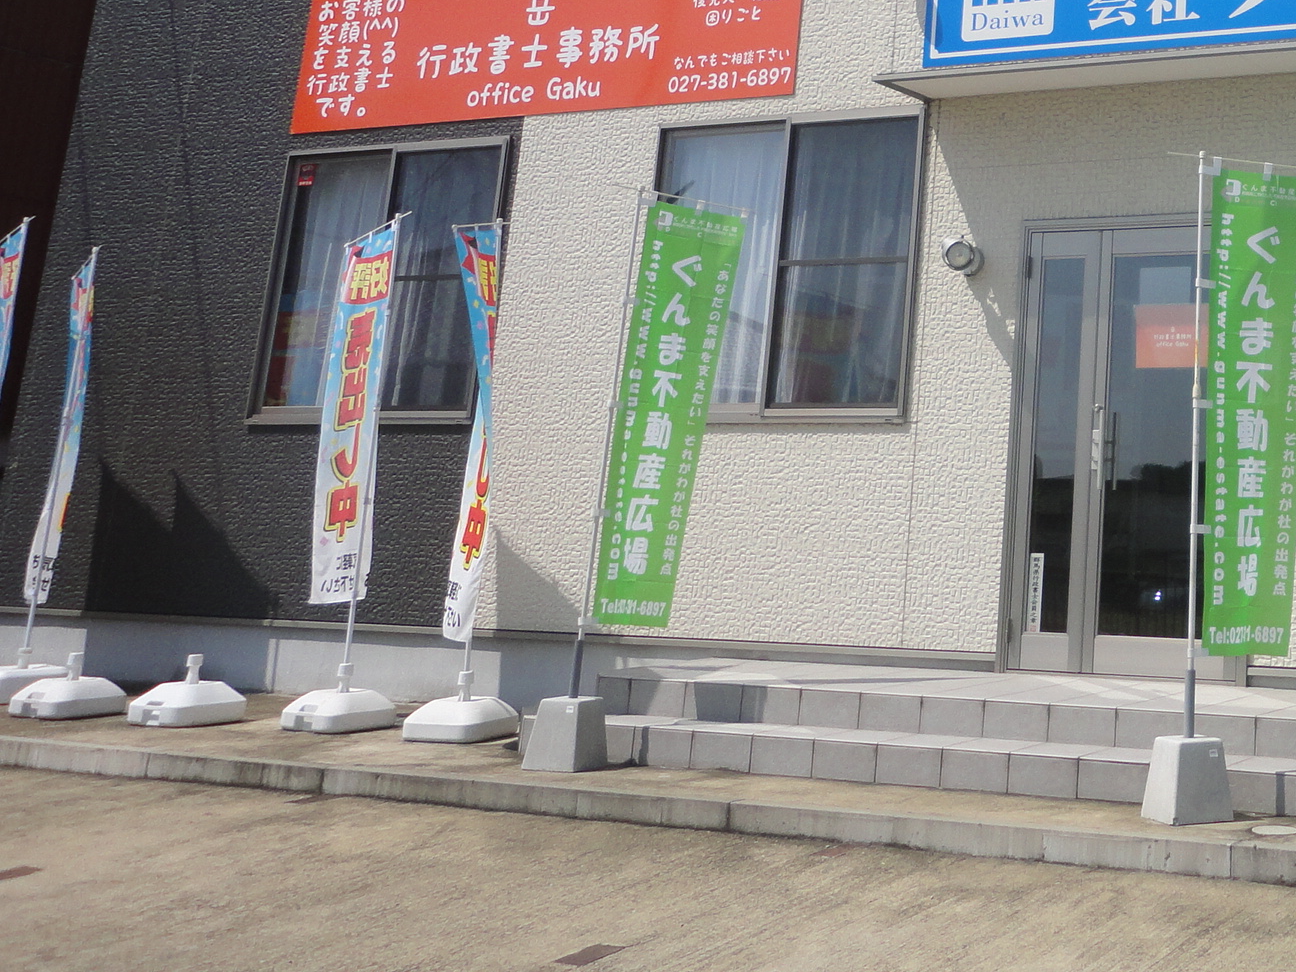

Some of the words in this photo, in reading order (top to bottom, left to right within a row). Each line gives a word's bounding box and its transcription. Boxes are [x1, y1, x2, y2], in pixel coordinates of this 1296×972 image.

[705, 6, 761, 26] 困りごと
[970, 9, 1044, 31] Daiwa
[313, 41, 396, 70] を支える
[416, 23, 660, 79] 行政書士事務所
[674, 48, 790, 70] なんでもご相談下さい
[306, 66, 393, 95] 行政書士
[466, 81, 534, 107] office
[546, 76, 600, 100] Gaku
[668, 66, 791, 93] 027-381-6897
[315, 94, 366, 118] です。
[623, 254, 702, 575] ぐんま不動産広場
[1213, 213, 1234, 606] http://www.gunma-estate.com
[1236, 226, 1280, 597] ぐんま不動産広場
